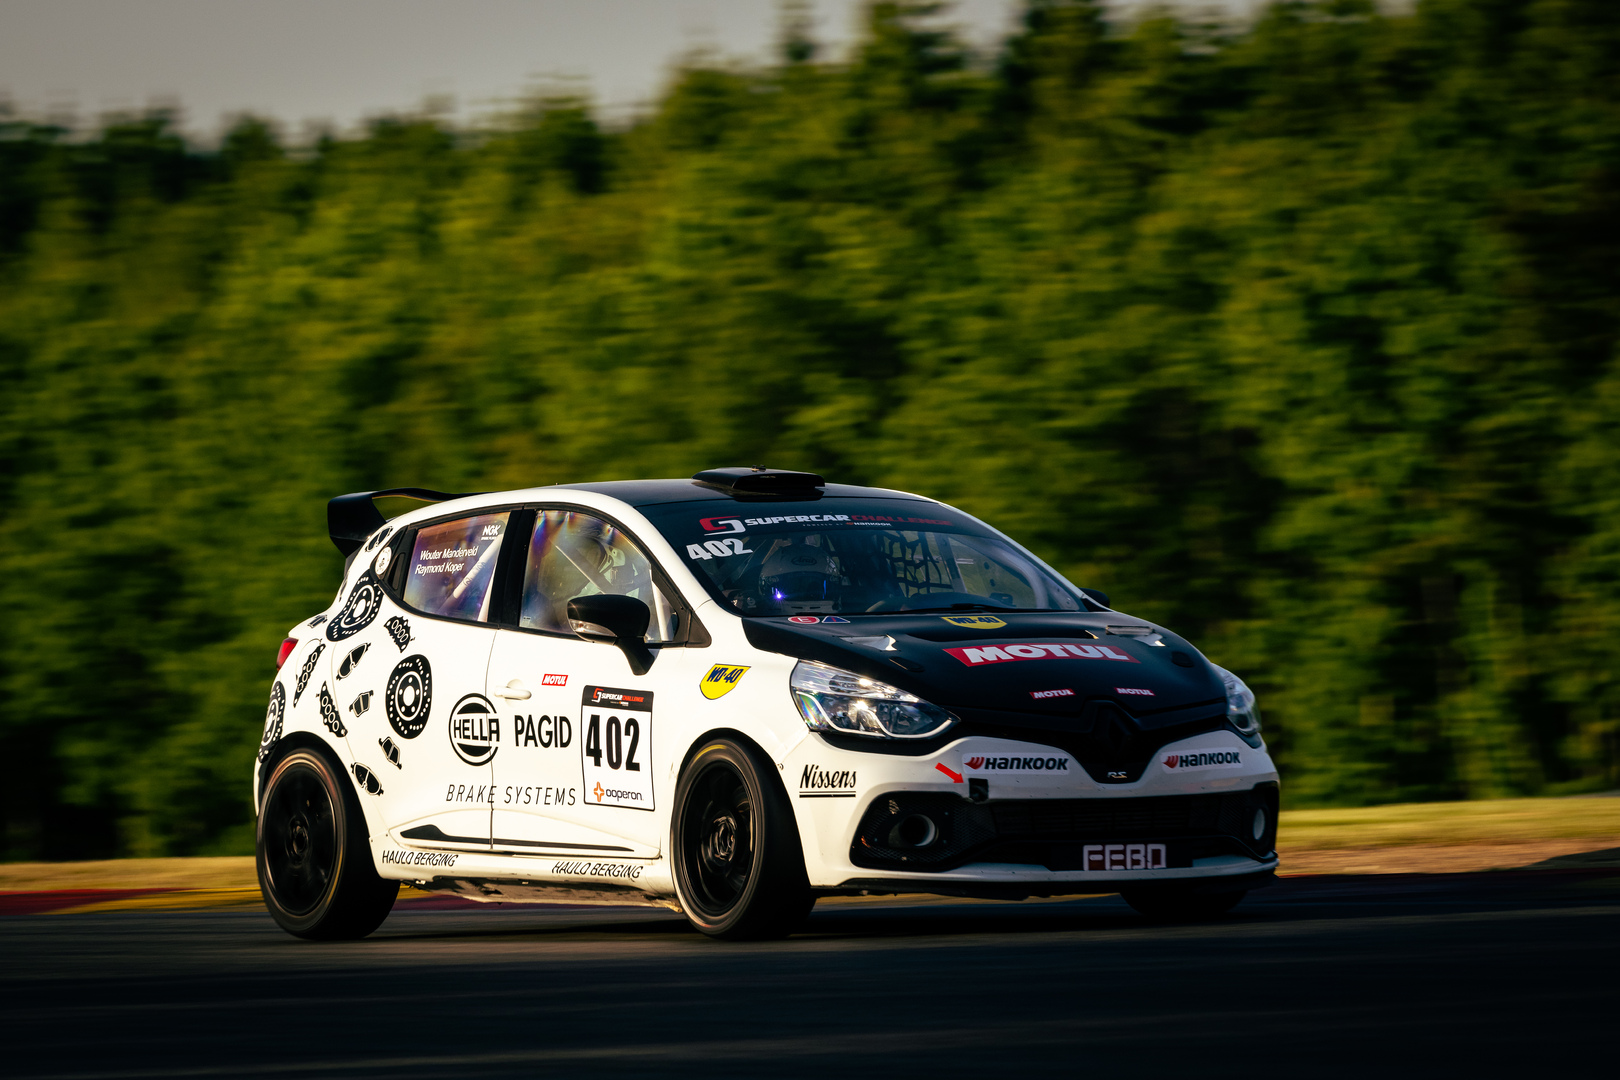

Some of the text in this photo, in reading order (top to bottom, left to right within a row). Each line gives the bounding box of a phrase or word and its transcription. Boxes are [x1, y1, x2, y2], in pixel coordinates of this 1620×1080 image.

[745, 514, 852, 526] SUPERCAR
[482, 525, 501, 536] NGK
[420, 549, 442, 560] Wouter
[686, 538, 753, 560] 402
[415, 562, 464, 576] Raymond Koper
[948, 616, 1000, 624] WD-40
[962, 644, 1129, 664] MOTUL
[543, 675, 566, 685] MOTUL
[706, 667, 744, 683] WD-40
[1033, 689, 1074, 699] MOTUL
[1117, 687, 1153, 696] MOTUL
[453, 718, 500, 742] HELLA
[514, 714, 572, 748] PAGID
[586, 714, 640, 771] 402
[800, 764, 857, 789] Nissens
[446, 784, 576, 806] BRAKE SYSTEMS
[382, 850, 459, 868] HAULO BERGING
[551, 861, 644, 879] HAULO BERGING
